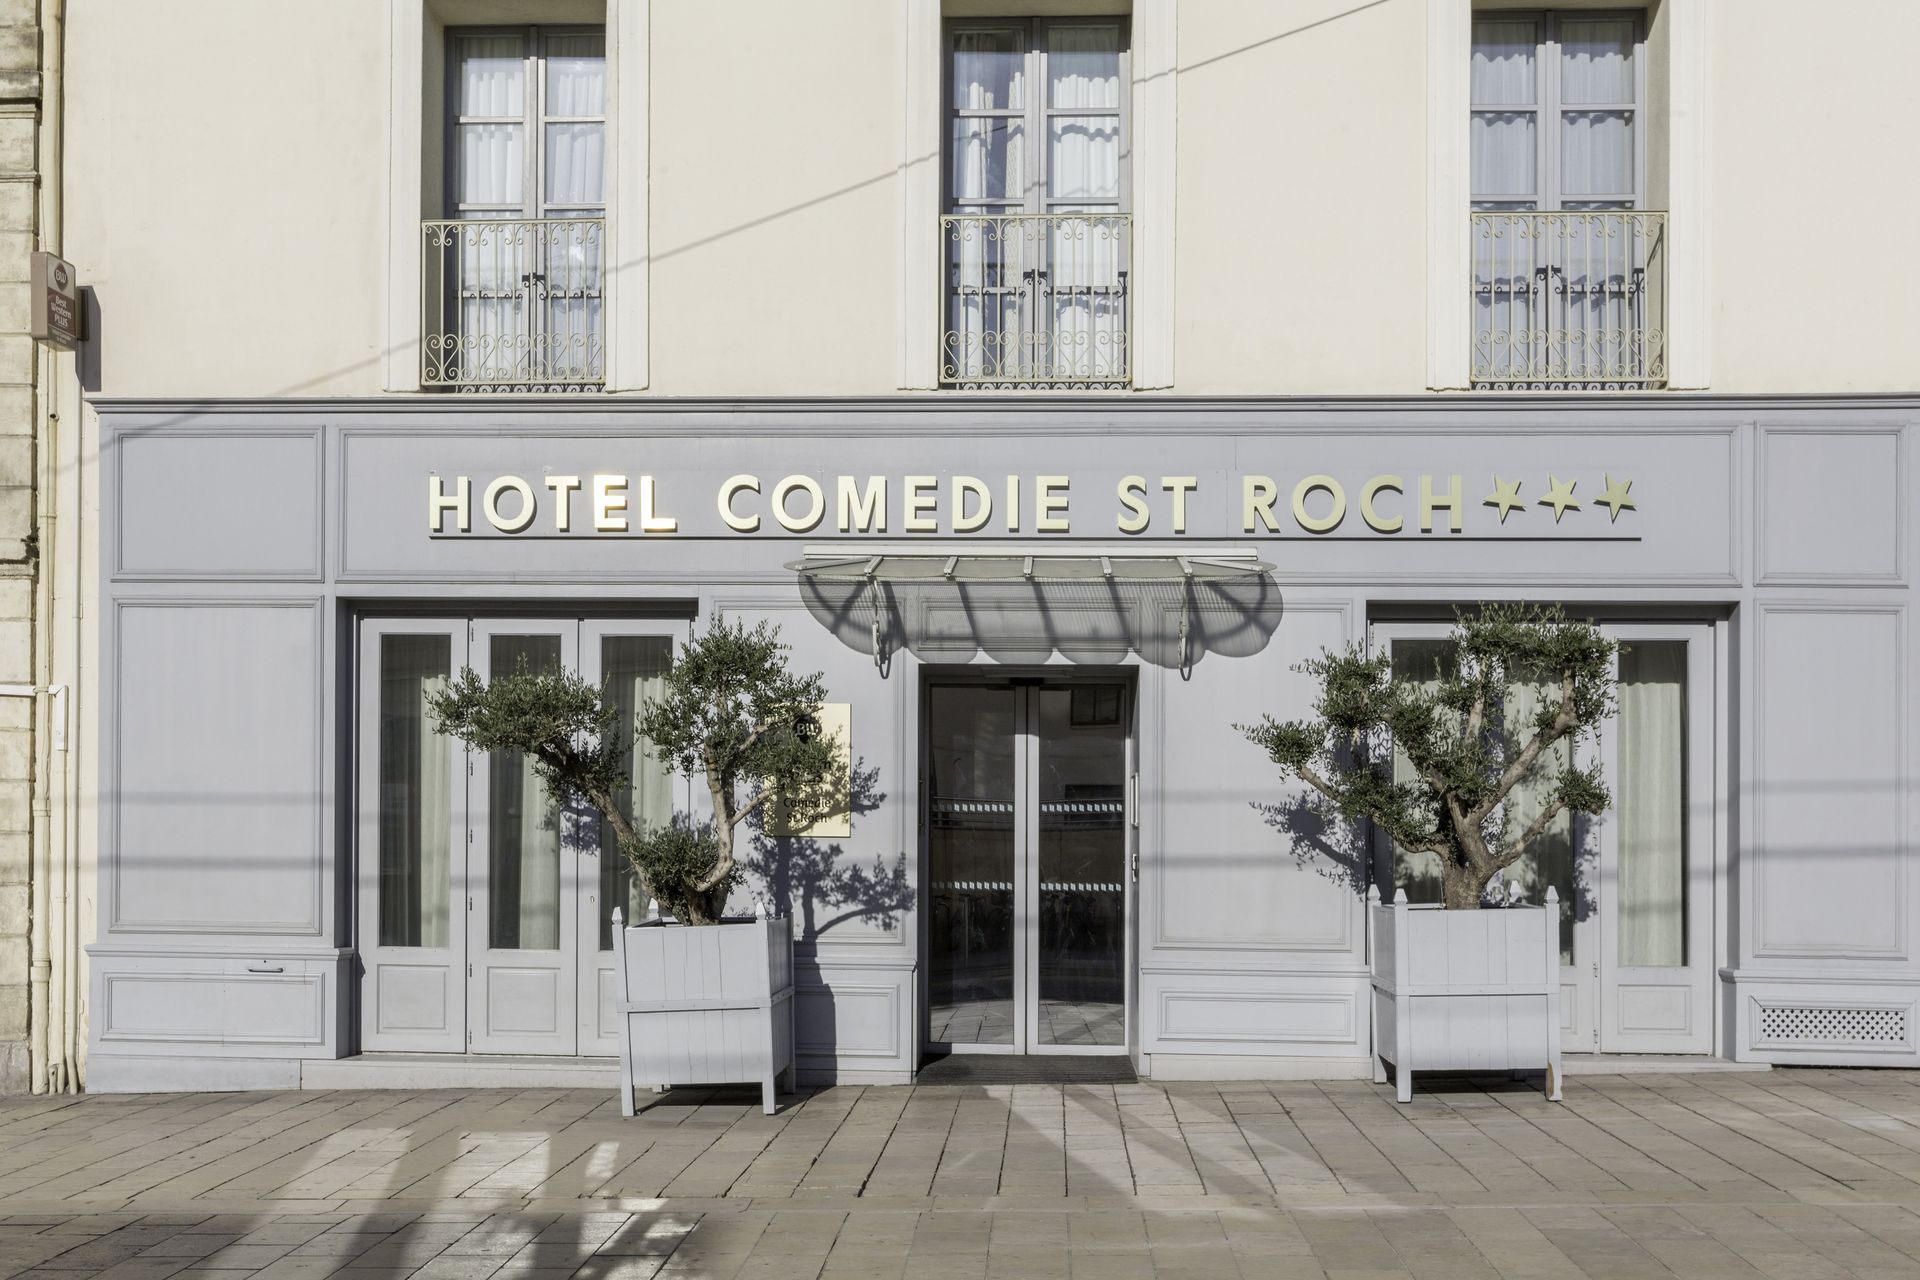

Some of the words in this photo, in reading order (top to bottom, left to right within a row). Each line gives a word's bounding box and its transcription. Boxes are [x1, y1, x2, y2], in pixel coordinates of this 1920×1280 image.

[56, 295, 67, 308] Best
[51, 302, 71, 319] Western
[55, 313, 68, 327] PLUS
[429, 475, 678, 532] HOTEL
[717, 474, 1070, 532] COMEDIE
[1117, 475, 1197, 532] ST
[1242, 474, 1463, 532] ROCH
[800, 812, 828, 824] Roch
